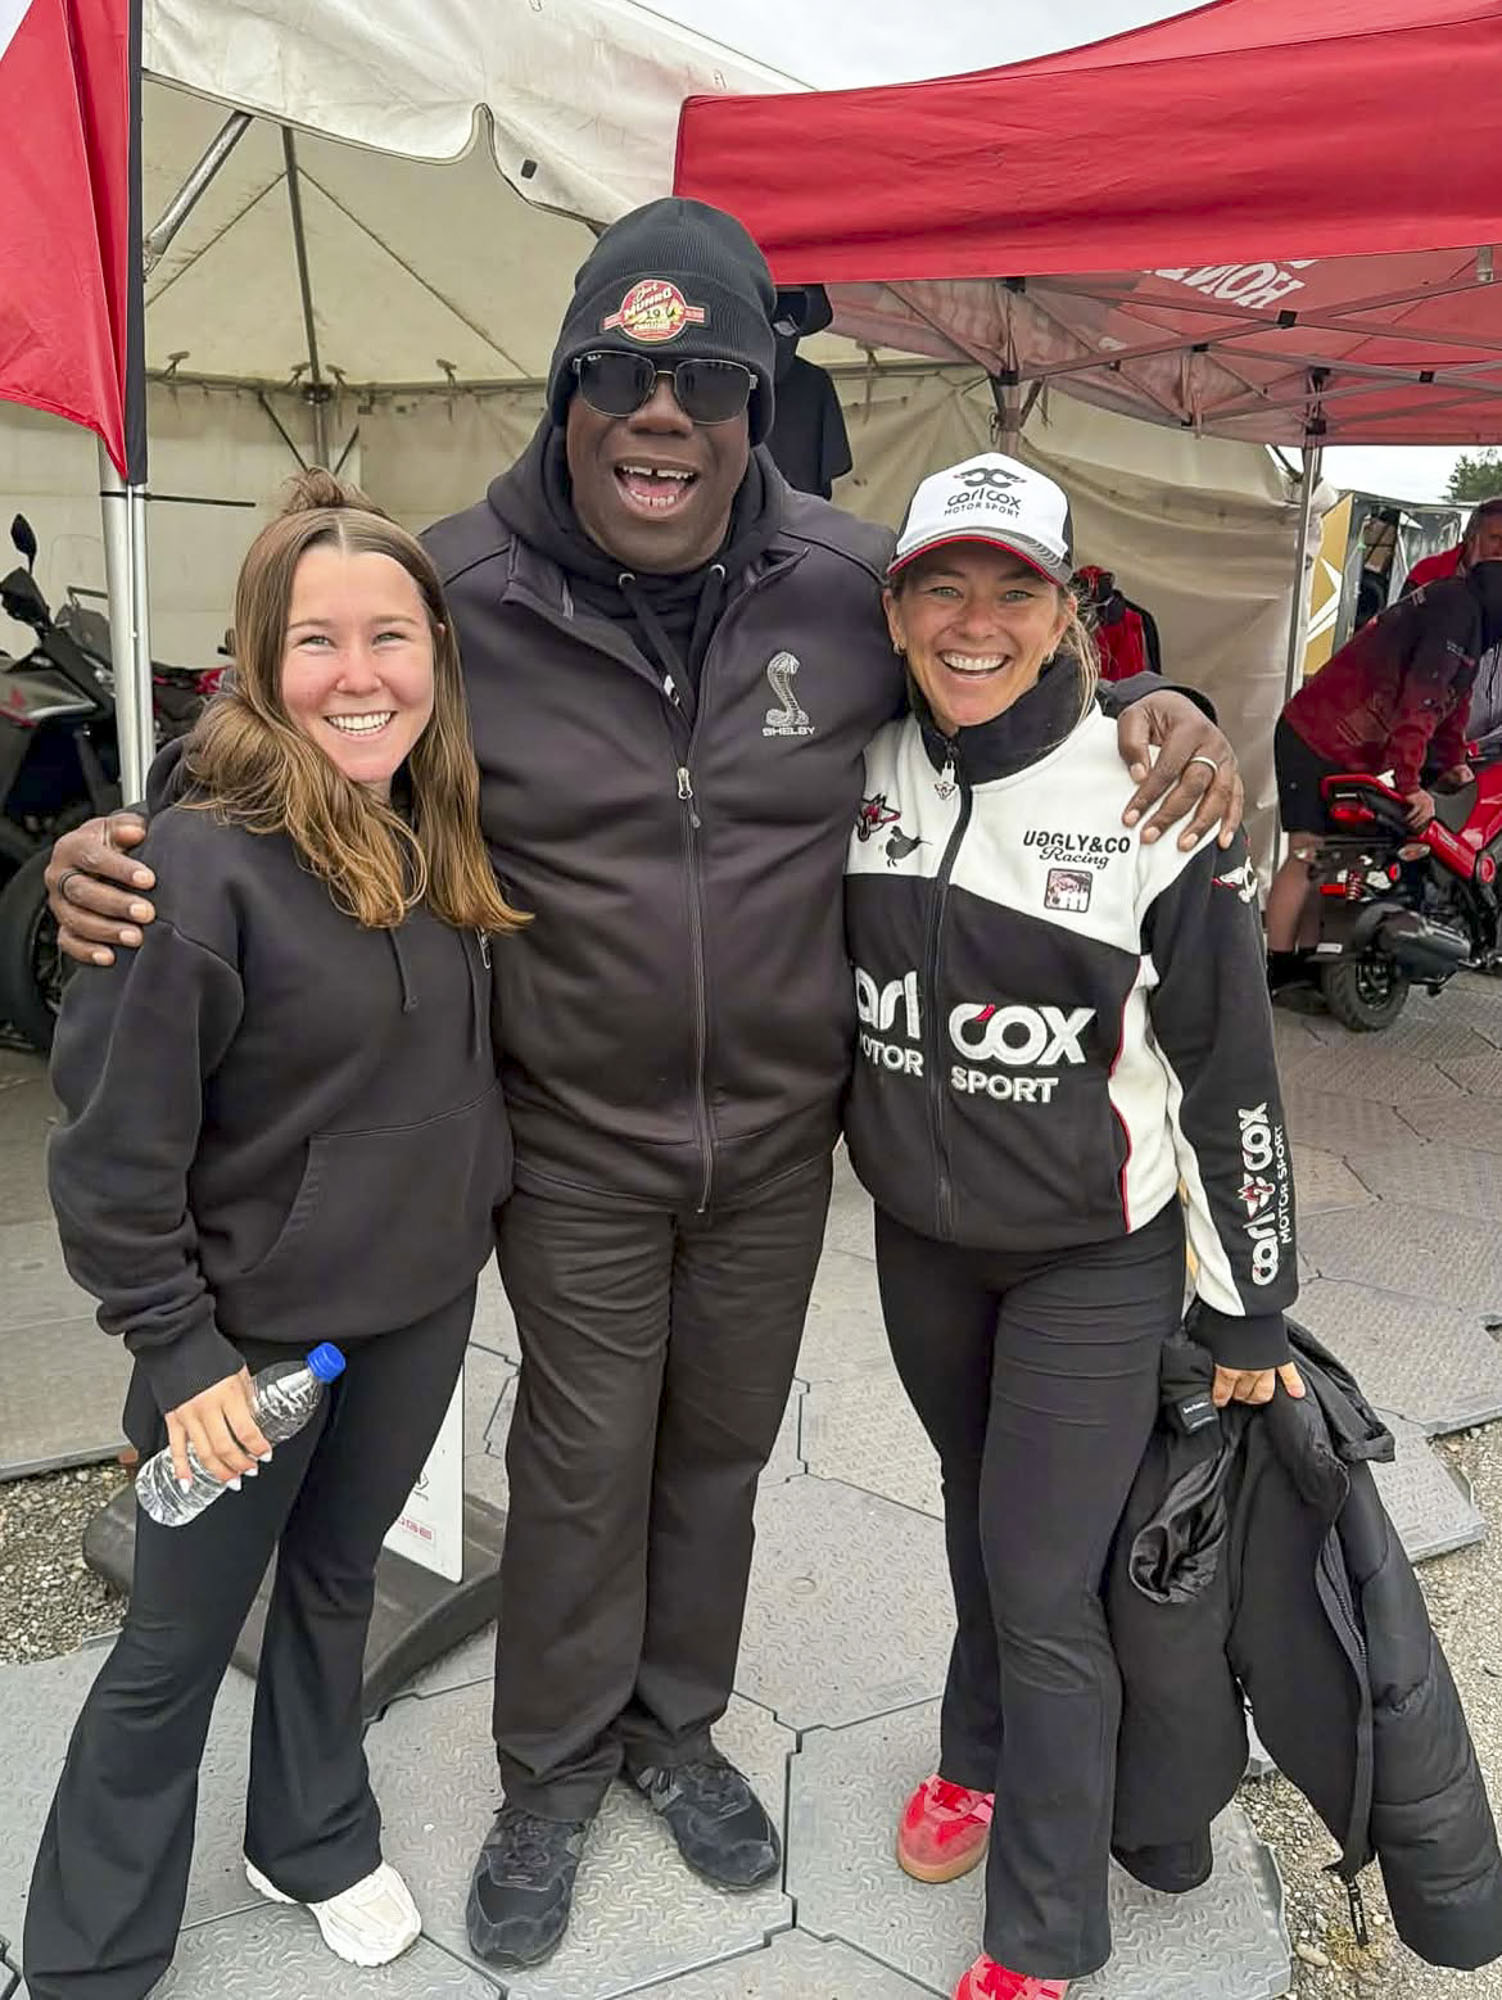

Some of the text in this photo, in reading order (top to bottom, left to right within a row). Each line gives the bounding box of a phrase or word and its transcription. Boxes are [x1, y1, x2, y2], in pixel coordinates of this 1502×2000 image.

[623, 287, 673, 322] MUNRO
[944, 501, 1020, 519] MOTOR SPORT
[762, 726, 815, 737] SHELBY
[1039, 845, 1110, 870] Racing
[855, 966, 921, 1040] arl
[860, 1030, 1060, 1103] OTOR SPORT
[1274, 1124, 1293, 1244] MOTOR SPORT
